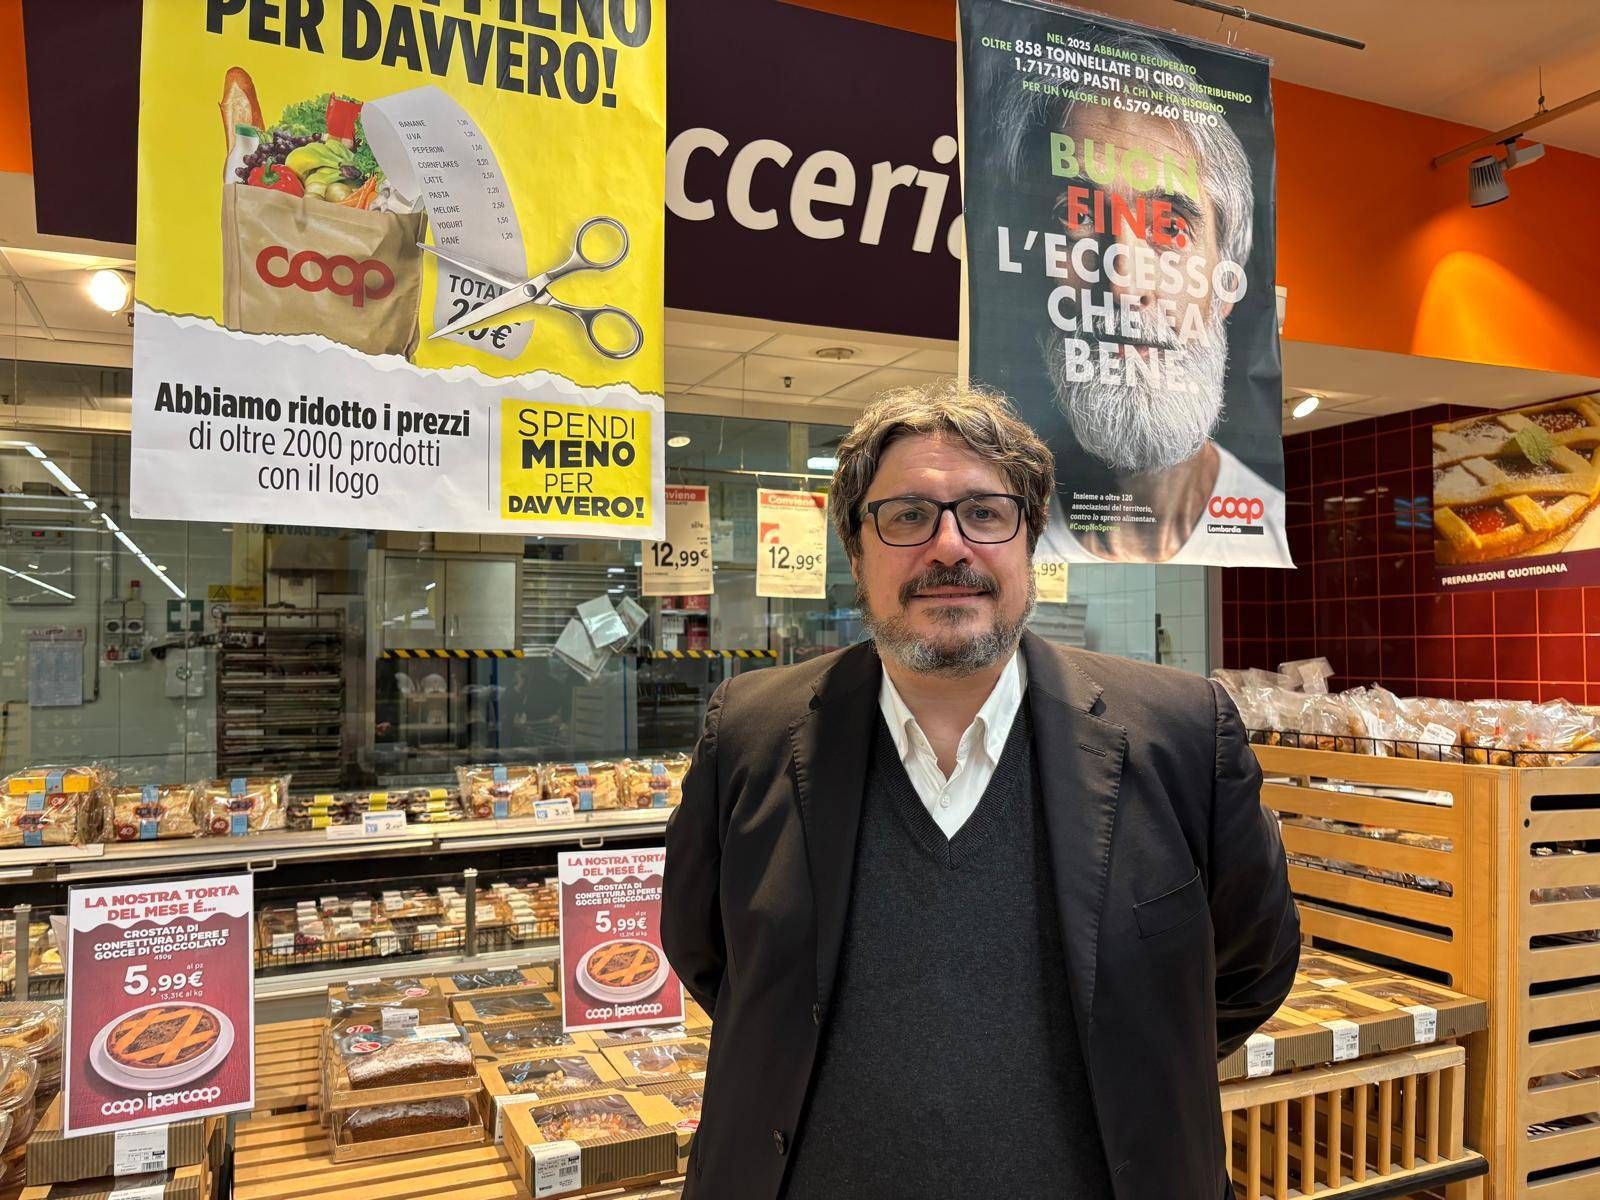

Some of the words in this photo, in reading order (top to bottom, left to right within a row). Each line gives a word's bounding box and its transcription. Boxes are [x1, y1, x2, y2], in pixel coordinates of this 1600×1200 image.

[464, 0, 651, 48] NO
[342, 0, 617, 108] DAVVERO!
[1047, 32, 1064, 44] NEL
[1067, 37, 1090, 51] 2025
[1093, 44, 1138, 62] ABBIAMO
[1140, 54, 1197, 75] RECUPERATO
[981, 37, 1012, 52] OLTRE
[1015, 40, 1042, 57] 858
[1046, 46, 1131, 77] TONNELLATE
[1135, 67, 1149, 81] DI
[1189, 82, 1252, 103] DISTRIBUENDO
[1015, 57, 1079, 83] 1.717.180
[1083, 72, 1120, 92] PASTI
[1132, 87, 1149, 98] CHI
[1151, 89, 1163, 101] NE
[1166, 92, 1180, 104] HA
[1182, 96, 1227, 115] BISOGNO,
[1022, 80, 1040, 92] PER
[1043, 84, 1059, 96] UN
[1061, 88, 1098, 105] VALORE
[1101, 97, 1111, 107] DI
[1113, 96, 1179, 120] 6.579.460
[418, 160, 460, 169] CORNFLAKES
[1050, 132, 1200, 199] BUON
[424, 176, 444, 184] LATTE
[429, 191, 449, 199] PASTA
[665, 127, 965, 260] cceri
[433, 206, 460, 214] MELONE
[437, 220, 463, 229] YOGURT
[441, 236, 460, 245] PANE
[256, 245, 395, 307] coop
[1047, 285, 1142, 339] CHE
[1157, 300, 1212, 347] FA
[1064, 338, 1199, 393] BENE.
[154, 382, 281, 422] Abbiamo
[289, 395, 377, 429] ridotto
[384, 403, 390, 430] i
[397, 410, 470, 437] prezzi
[518, 408, 635, 440] SPENDI
[189, 421, 211, 450] di
[220, 424, 276, 455] oltre
[283, 427, 342, 459] 2000
[350, 437, 440, 467] prodotti
[522, 439, 635, 469] MENO
[258, 465, 299, 491] con
[308, 463, 320, 492] il
[329, 464, 379, 499] logo
[545, 472, 593, 493] PER
[509, 496, 644, 518] DAVVERO!
[1072, 503, 1110, 511] associazioni
[1112, 504, 1121, 512] del
[1073, 492, 1098, 501] Insieme
[1105, 493, 1120, 501] oltre
[1121, 494, 1133, 502] 120
[1093, 513, 1099, 521] lo
[1208, 496, 1264, 524] coop
[1208, 525, 1242, 534] Lombardia
[651, 542, 709, 569] 12,99€
[769, 546, 822, 572] 12,99€
[1442, 570, 1505, 586] PREPARAZIONE
[1507, 563, 1568, 579] QUOTIDIANA
[568, 858, 583, 867] LA
[585, 855, 628, 866] NOSTRA
[583, 867, 603, 876] DEL
[606, 866, 635, 875] MESE
[84, 896, 108, 908] LA
[112, 889, 182, 906] NOSTRA
[186, 885, 239, 900] TORTA
[575, 890, 626, 899] CONFETTURA
[575, 897, 601, 906] GOCCE
[612, 894, 661, 904] CIOCCOLATO
[107, 908, 140, 921] DEL
[145, 903, 189, 918] MESE
[596, 910, 647, 935] 5,99€
[94, 937, 173, 951] CONFETTURA
[176, 934, 188, 942] DI
[190, 930, 219, 941] PERE
[221, 928, 229, 937] E
[124, 925, 184, 939] CROSTATA
[187, 924, 198, 933] DI
[94, 949, 135, 960] GOCCE
[138, 947, 150, 956] DI
[153, 938, 226, 954] CIOCCOLATO
[123, 964, 203, 996] 5,99€
[586, 1009, 613, 1020] coop
[614, 1003, 662, 1018] ipercoop
[101, 1097, 143, 1116] coop
[147, 1086, 220, 1111] ipercoop
